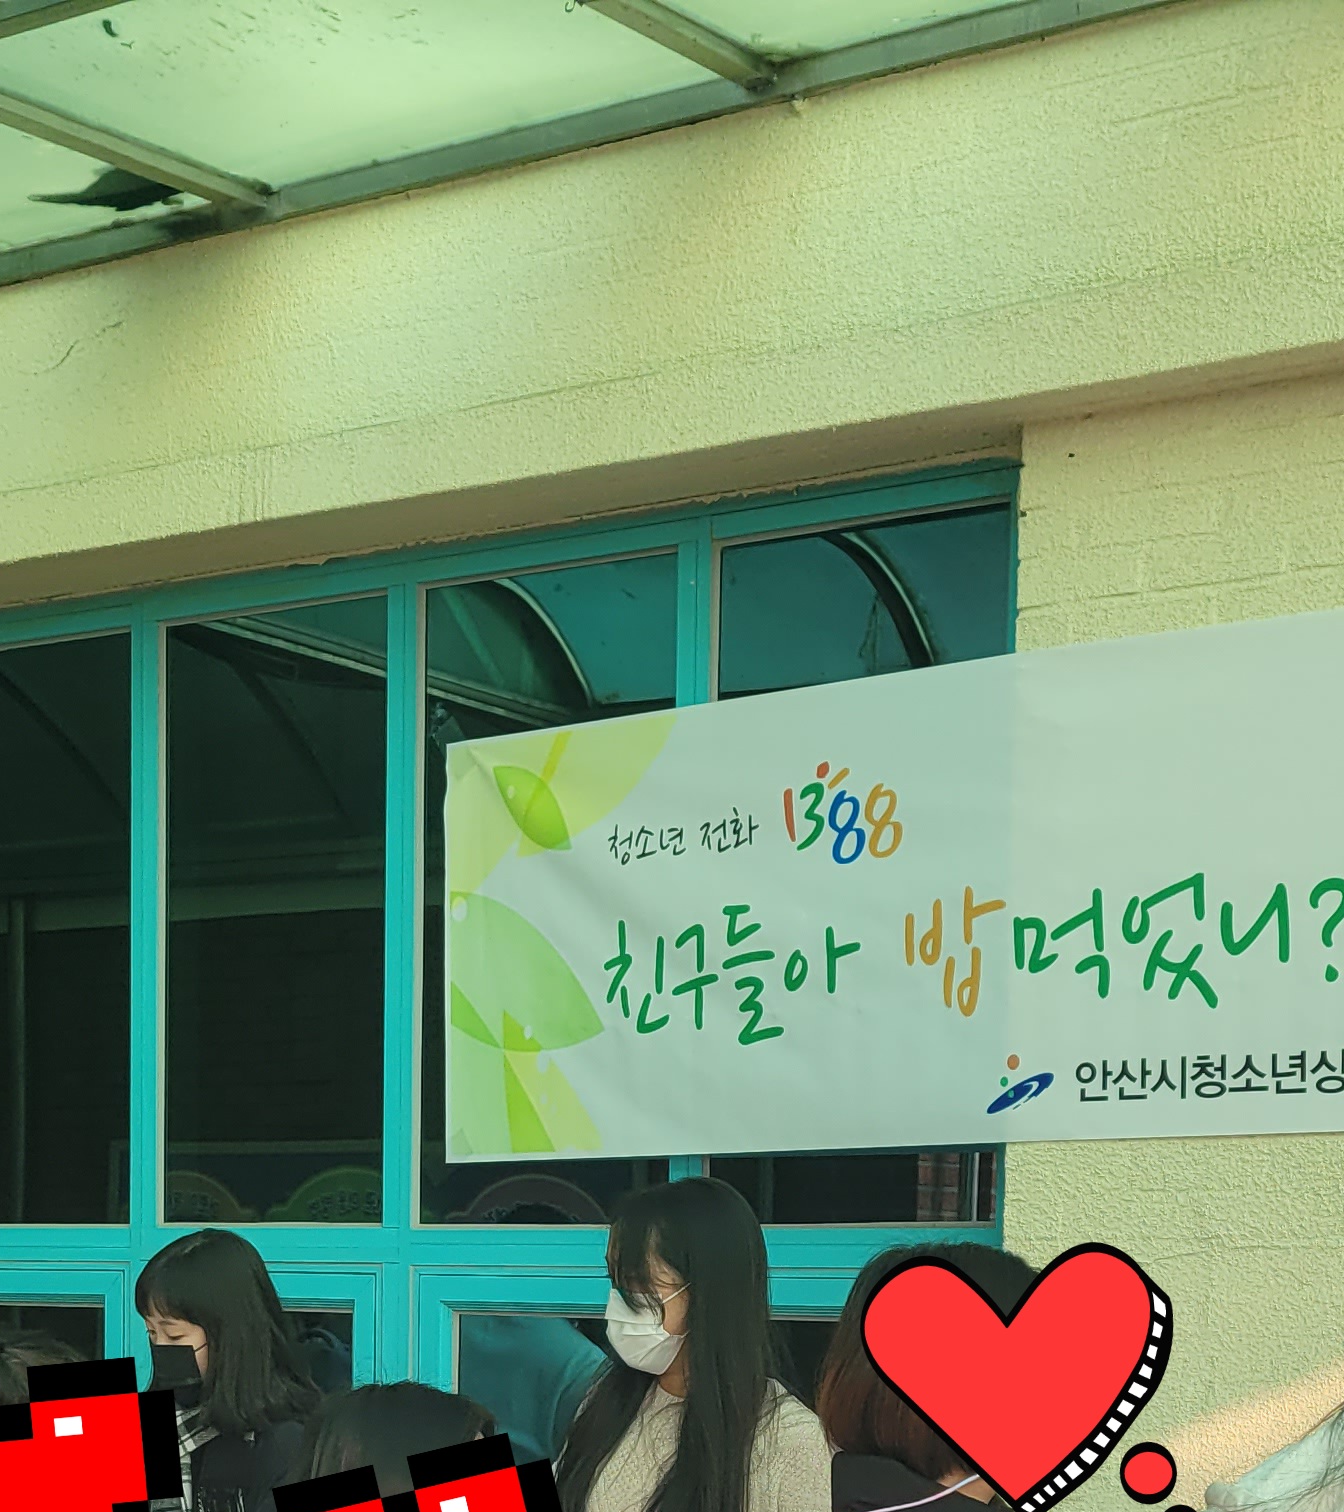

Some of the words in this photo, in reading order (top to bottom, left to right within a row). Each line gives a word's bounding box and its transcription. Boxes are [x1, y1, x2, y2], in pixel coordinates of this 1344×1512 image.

[607, 823, 687, 866] 청소년
[699, 805, 761, 853] 전화
[782, 780, 904, 865] 1388
[603, 903, 862, 1047] 친구들아
